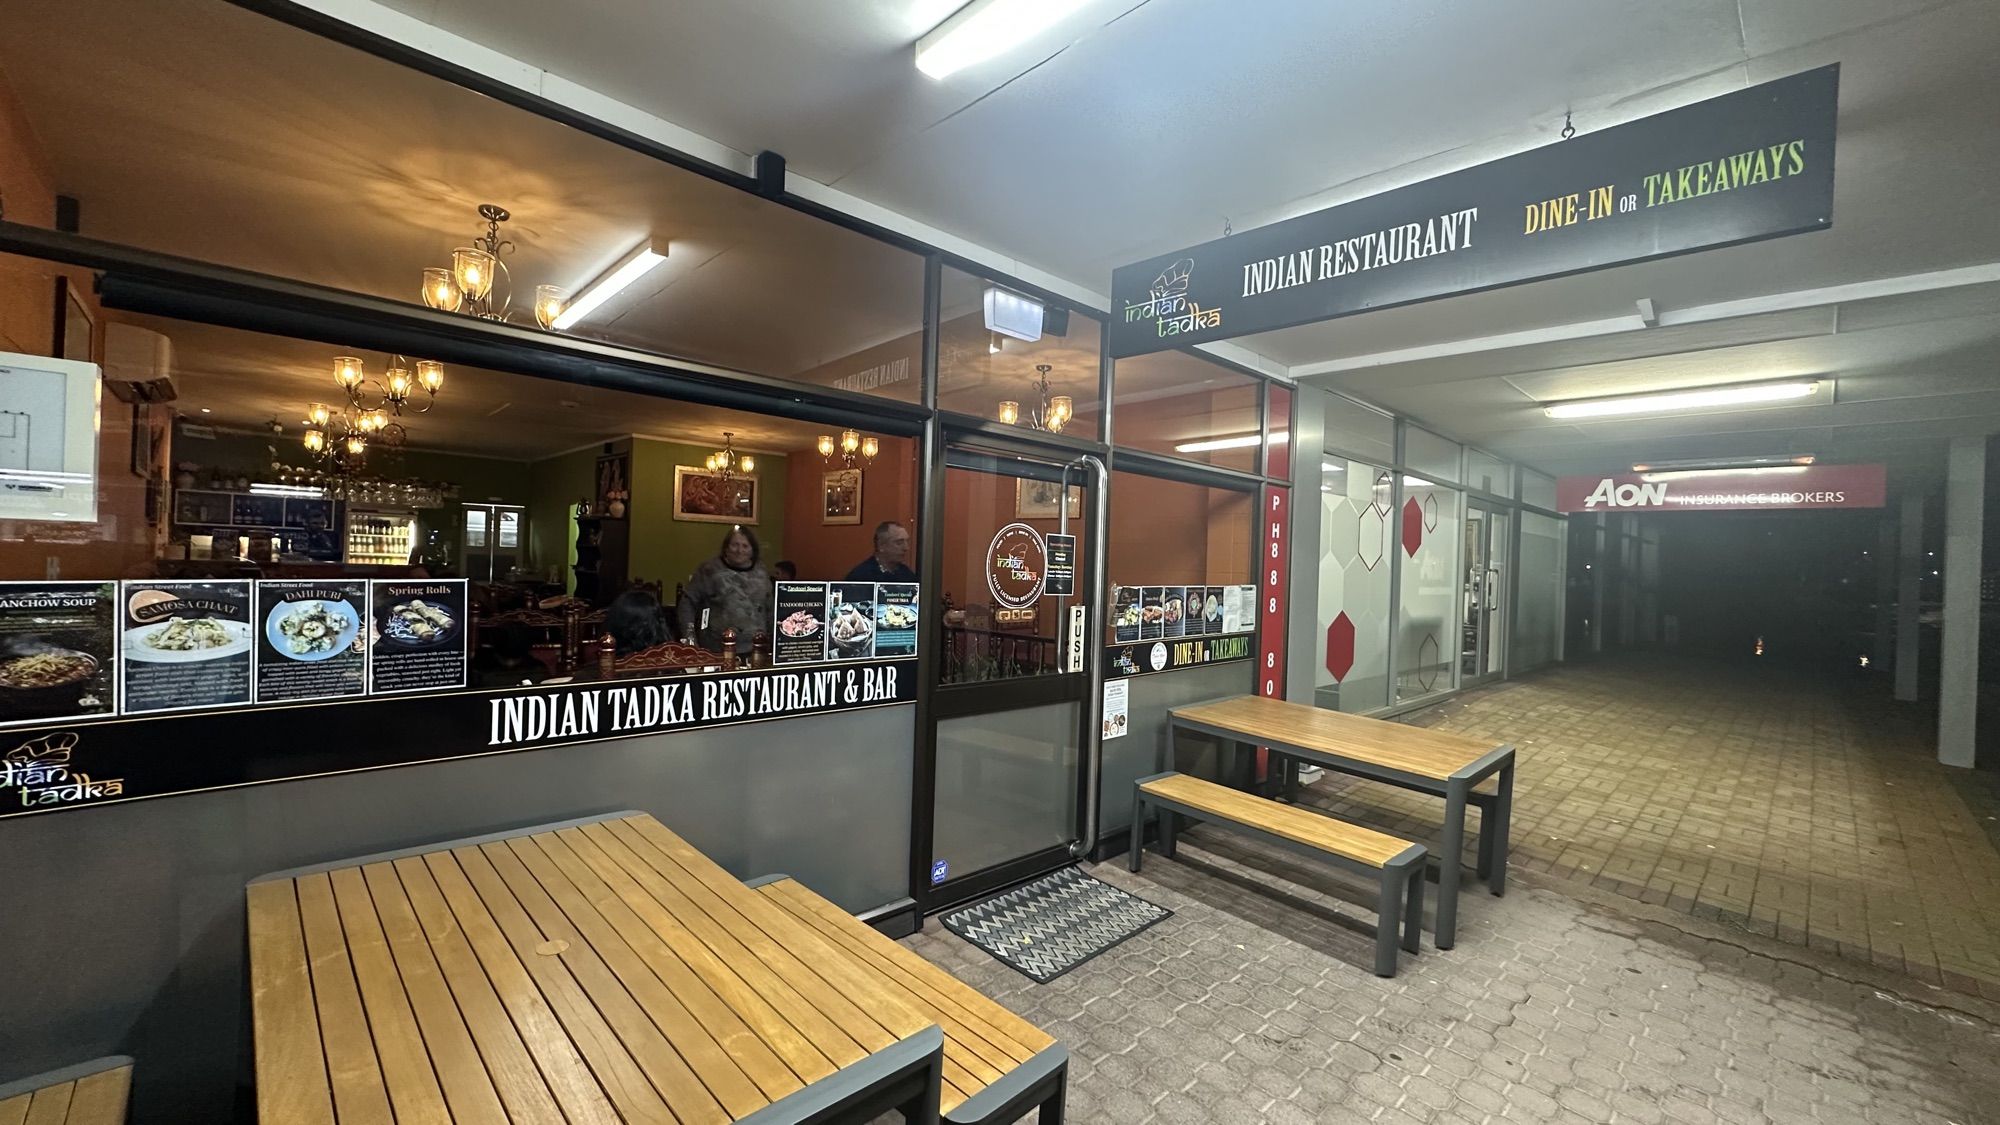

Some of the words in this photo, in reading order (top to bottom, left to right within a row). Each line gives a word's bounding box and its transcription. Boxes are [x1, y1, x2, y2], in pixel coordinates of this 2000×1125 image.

[1524, 185, 1614, 234] DINE-IN
[1620, 195, 1637, 213] OR
[1643, 139, 1805, 208] TAKEAWAYS
[1242, 249, 1314, 298] INDIAN
[1318, 208, 1478, 280] RESTAURANT
[1124, 290, 1187, 323] indian
[1156, 303, 1222, 338] tadka
[1584, 479, 1667, 507] AON
[1680, 493, 1769, 505] INSURANCE
[1771, 491, 1845, 504] BROKERS
[997, 554, 1025, 569] indian
[1011, 566, 1037, 580] tadka
[63, 598, 97, 607] SOUP
[285, 590, 314, 601] DAHI
[316, 590, 342, 600] PURI
[388, 587, 423, 596] Spring
[426, 586, 451, 594] Rolls
[140, 600, 194, 617] SAMOSA
[196, 599, 238, 614] CHAAT
[1074, 609, 1082, 668] PUSH
[1174, 641, 1204, 666] DINE-IN
[1211, 637, 1249, 661] TAKEAWAYS
[488, 690, 601, 746] INDIAN
[608, 682, 696, 732] TADKA
[702, 669, 841, 720] RESTAURANT
[844, 671, 858, 704] &
[861, 666, 898, 703] BAR
[18, 773, 124, 806] tadka
